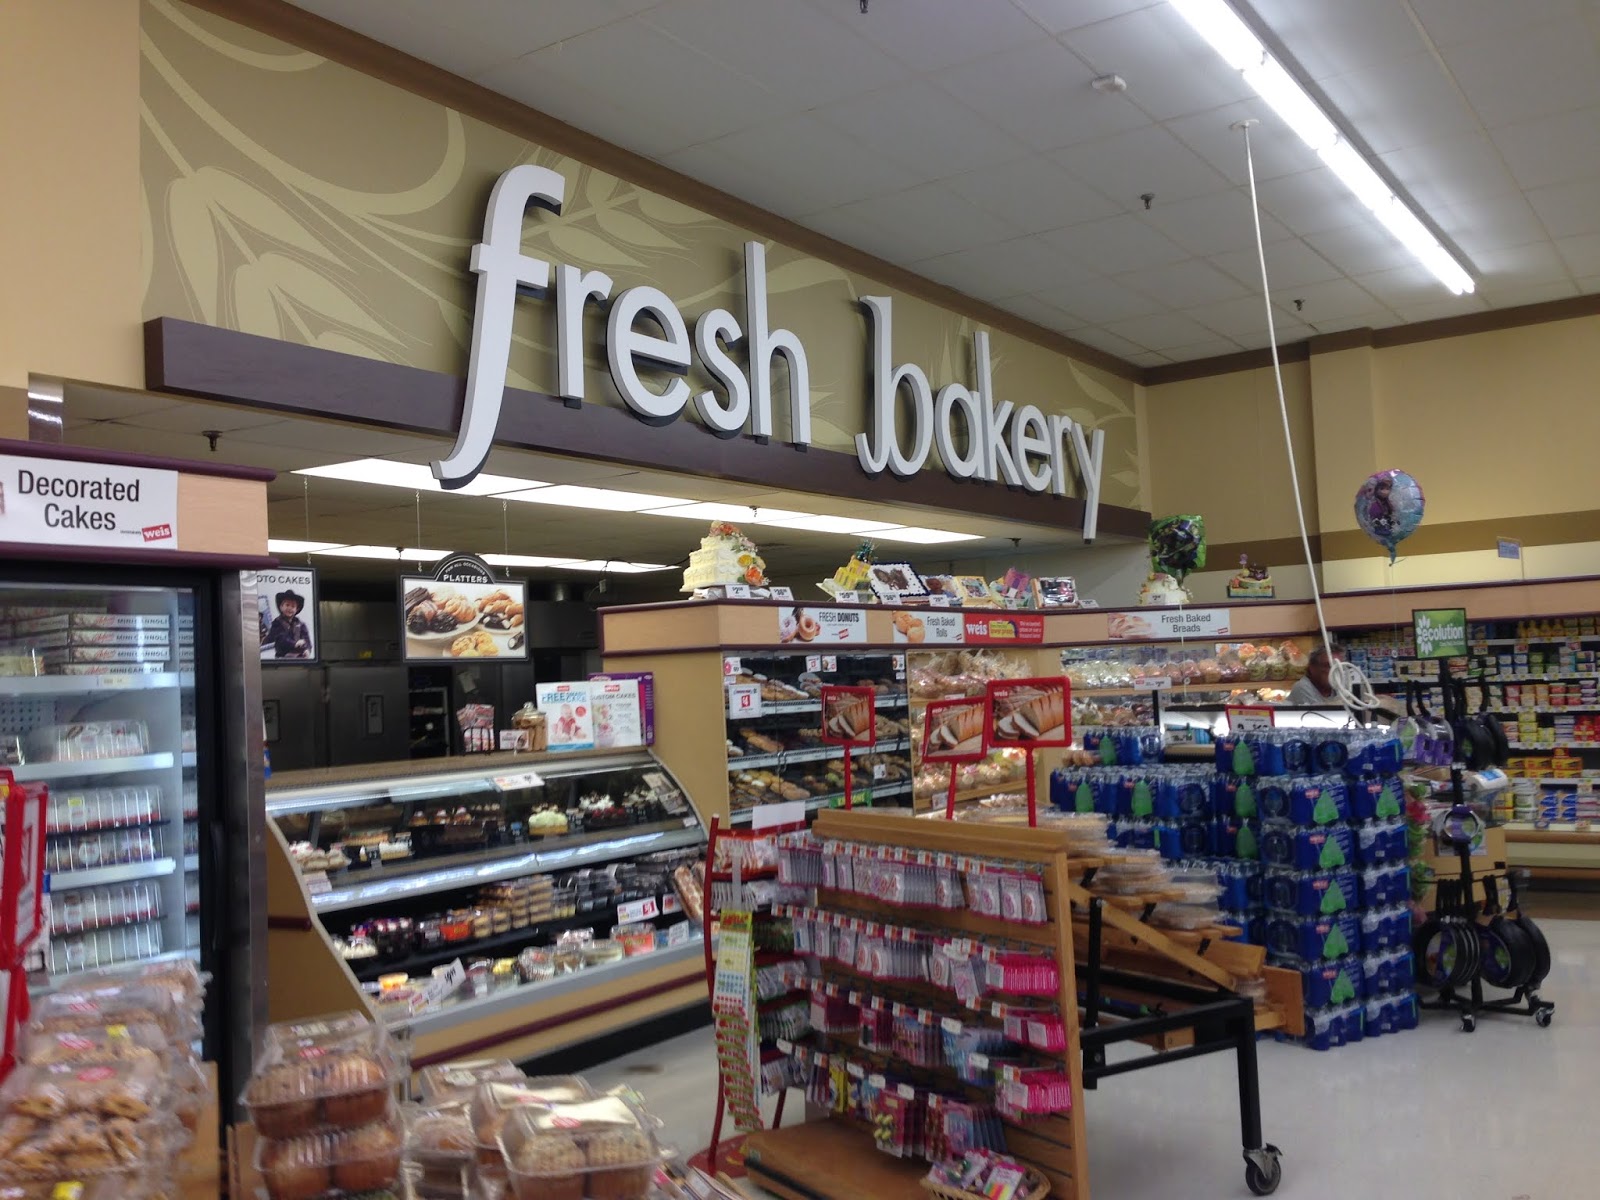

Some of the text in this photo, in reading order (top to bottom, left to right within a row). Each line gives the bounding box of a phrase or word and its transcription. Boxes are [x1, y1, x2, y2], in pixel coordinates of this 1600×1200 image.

[430, 164, 1105, 541] fresh bakery
[18, 469, 140, 502] Decorated
[44, 503, 116, 531] Cakes
[143, 526, 171, 540] weis
[256, 574, 311, 585] OTO CAKES
[443, 574, 489, 584] PLATTERS
[818, 611, 860, 623] FRESH DONUTS
[926, 616, 956, 627] Fresh Baked
[1161, 613, 1211, 623] Fresh Baked
[935, 627, 948, 638] Rolls
[965, 620, 988, 636] weis
[1172, 624, 1201, 633] Breads
[1421, 623, 1464, 641] ecolution
